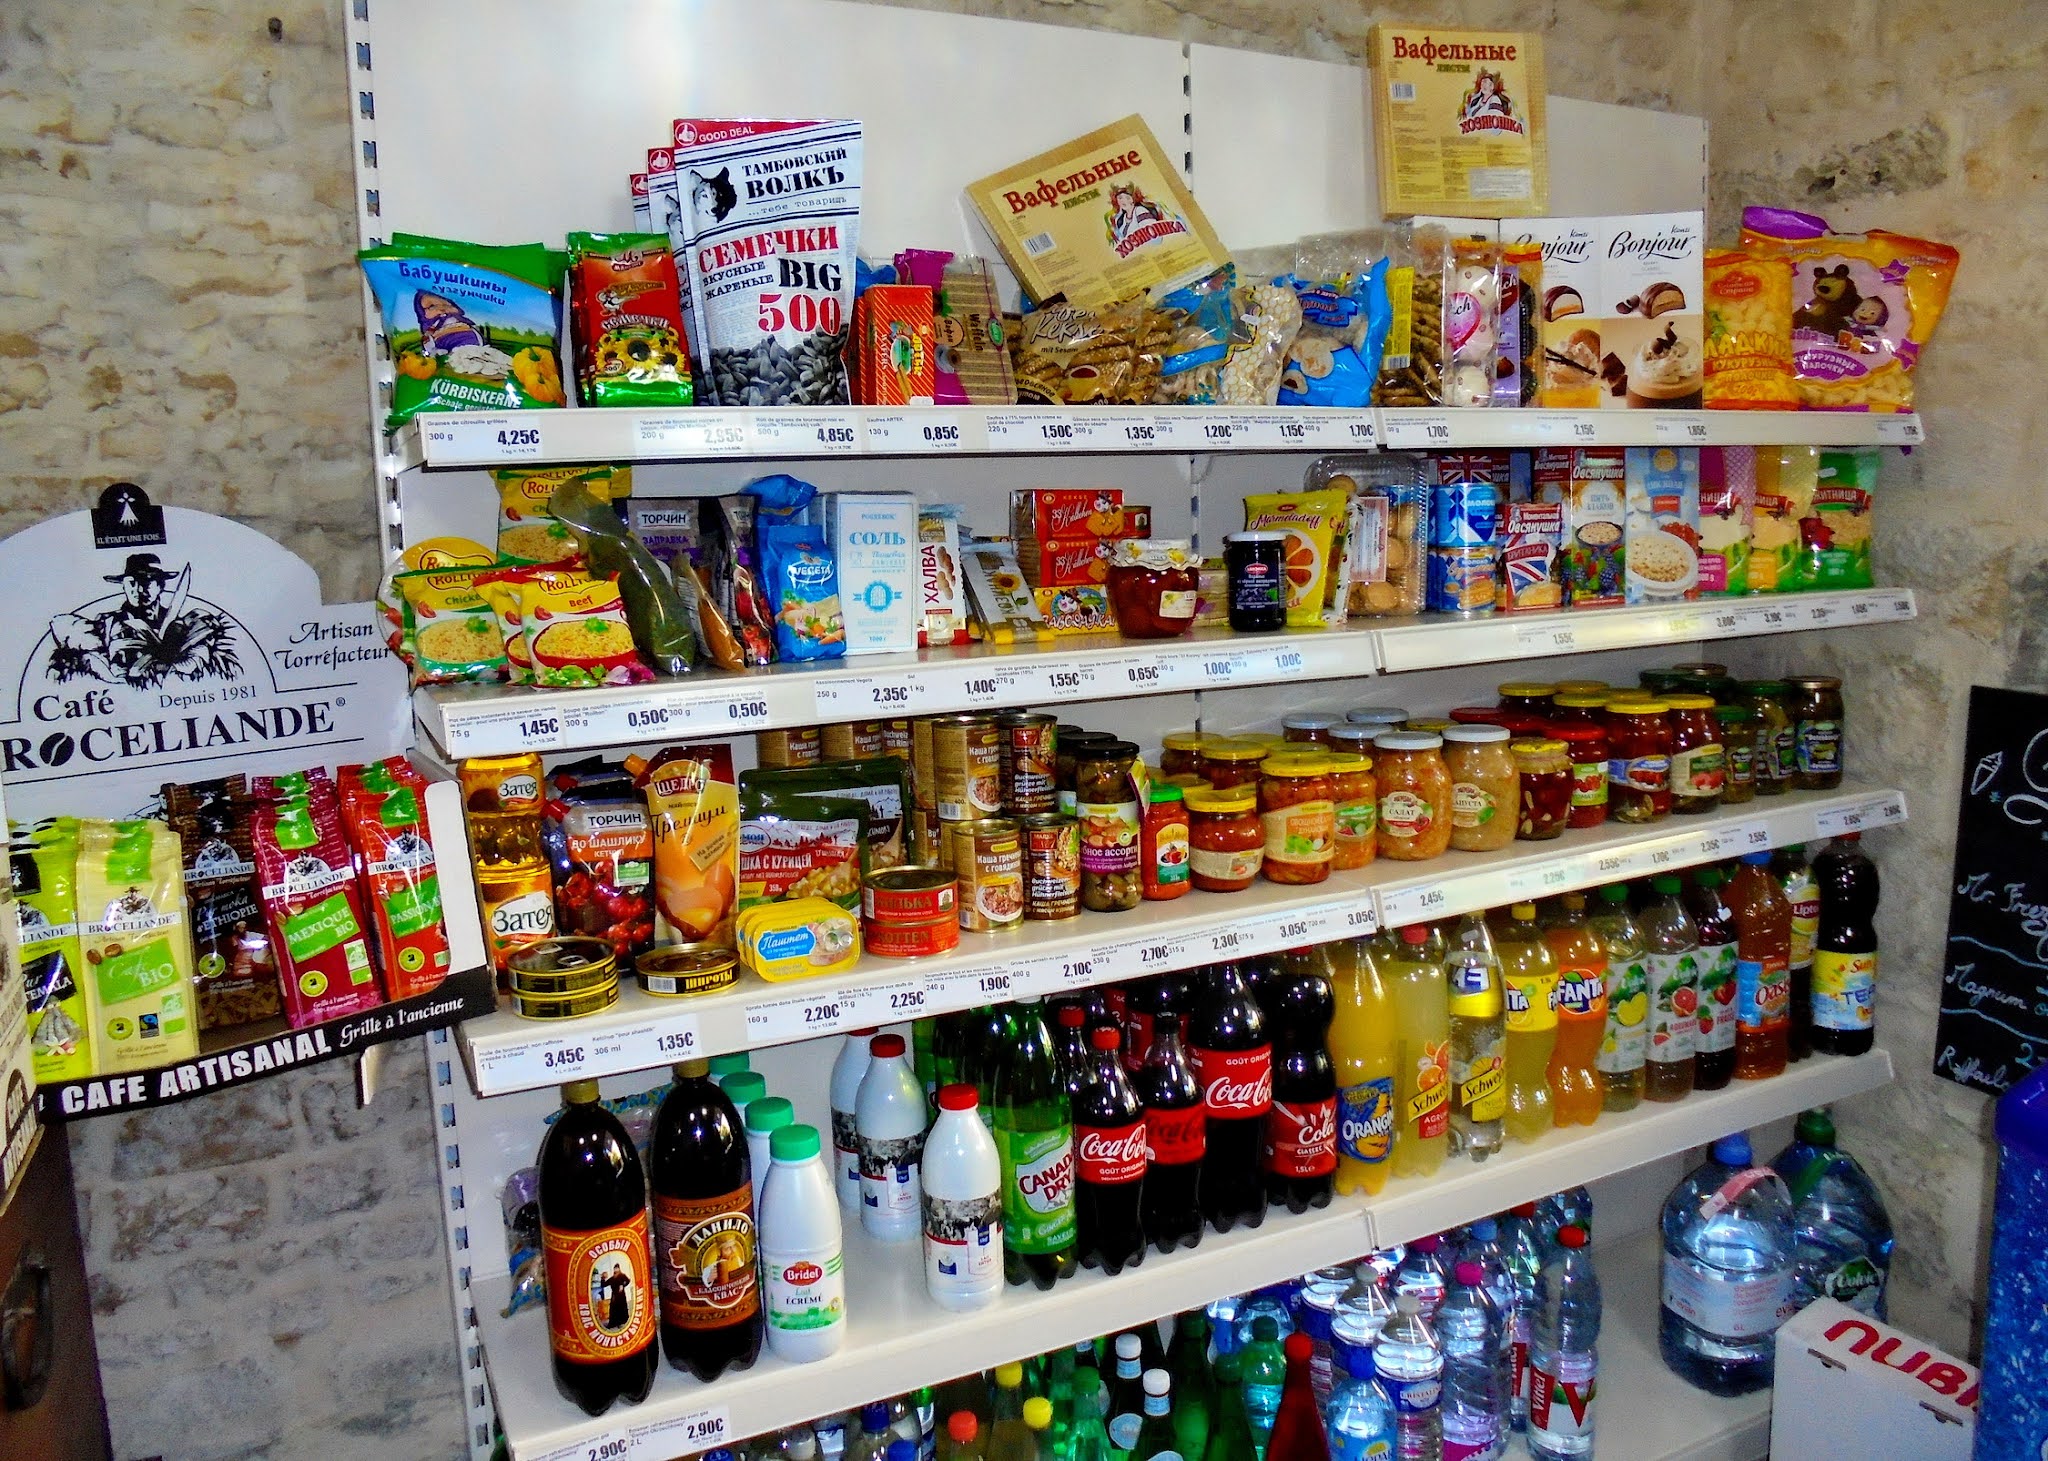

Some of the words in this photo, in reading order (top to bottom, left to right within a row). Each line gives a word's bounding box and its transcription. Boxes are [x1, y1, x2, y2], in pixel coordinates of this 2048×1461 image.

[1392, 37, 1517, 66] Вафельные
[1459, 114, 1523, 135] ХОЗЯЮШКА
[699, 130, 726, 142] GOOD
[730, 126, 754, 137] DEAL
[742, 147, 847, 177] ТАМБОВСКИЙ
[746, 166, 844, 200] ВОЛКЪ
[1002, 148, 1142, 214] Вафельные
[1114, 221, 1187, 258] ХОЗЯЮШКА
[1608, 230, 1696, 262] Bonjour
[700, 226, 838, 272] СЕМЕЧКИ
[399, 262, 508, 294] Бабушкины
[703, 261, 766, 287] ВКУСНЫЕ
[778, 258, 842, 292] BIG
[706, 274, 774, 300] ЖАРЕНЫЕ
[758, 293, 841, 336] 500
[970, 314, 986, 350] Waffeln
[430, 378, 523, 409] KÜRBISKERNE
[498, 429, 539, 446] 4,25€
[641, 431, 656, 439] 200
[817, 428, 854, 442] 4,85€
[923, 426, 958, 441] 0,85€
[1041, 425, 1072, 438] 1,50€
[1125, 427, 1154, 439] 1,35€
[1204, 425, 1232, 438] 1,20€
[1279, 425, 1304, 437] 1,15€
[1350, 424, 1373, 437] 1,70€
[1426, 426, 1448, 438] 1,70€
[1574, 424, 1594, 435] 2,15€
[1573, 466, 1624, 480] Овсянушка
[642, 514, 686, 524] ТОРЧИН
[1507, 521, 1560, 534] Овсянушка
[130, 534, 145, 543] UNE
[642, 535, 689, 544] ЗАПРАВКА
[849, 531, 906, 545] СОЛЬ
[921, 544, 939, 604] ХАЛВА
[569, 596, 593, 607] Beef
[289, 621, 373, 644] Artisan
[1553, 632, 1574, 644] 1,55€
[275, 647, 392, 671] Torréfacteur
[1275, 653, 1301, 668] 1,00€
[1128, 666, 1159, 682] 0,65€
[1204, 661, 1231, 675] 1,00€
[965, 679, 996, 695] 1,40€
[1049, 672, 1080, 688] 1,55€
[159, 690, 215, 710] Depuis
[221, 685, 258, 701] 1981
[873, 687, 908, 703] 2,35€
[33, 688, 115, 724] Café
[669, 709, 683, 717] 300
[729, 702, 767, 719] 0,50€
[565, 719, 580, 727] 300
[628, 708, 669, 727] 0,50€
[520, 718, 559, 737] 1,45€
[969, 746, 988, 756] Каша
[499, 779, 538, 799] Затея
[655, 777, 706, 796] ЩЕДРО
[588, 813, 641, 826] ТОРЧИН
[589, 834, 645, 848] ШАШЛИКУ
[772, 854, 812, 869] КУРИЦЕЙ
[977, 855, 998, 864] Каша
[184, 864, 255, 880] BROCELIANDE
[272, 871, 346, 896] BROCELIANDE
[1420, 890, 1444, 907] 2,45€
[88, 915, 172, 933] BROCELIANDE
[288, 906, 351, 945] MEXIQUE
[493, 904, 554, 932] Затея
[1348, 909, 1374, 926] 3,05€
[336, 920, 354, 937] BIO
[1280, 922, 1307, 938] 3,05€
[762, 932, 809, 949] Паштет
[1212, 933, 1239, 950] 2,30€
[1141, 945, 1169, 962] 2,70€
[139, 963, 174, 987] BIO
[1063, 961, 1092, 978] 2,10€
[685, 971, 733, 989] ШПРОТЫ
[979, 976, 1010, 992] 1,90€
[1946, 963, 2027, 1010] Magnum
[1558, 977, 1604, 1002] FANTA
[890, 991, 924, 1009] 2,25€
[748, 1015, 761, 1023] 160
[762, 1015, 768, 1023] g
[805, 1004, 840, 1022] 2,20€
[657, 1031, 694, 1052] 1,35€
[62, 1078, 148, 1115] CAFE
[159, 1028, 332, 1098] ARTISANAL
[384, 1016, 395, 1032] à
[397, 995, 466, 1028] l'ancienne
[544, 1046, 585, 1069] 3,45€
[594, 1046, 609, 1056] 306
[481, 1063, 485, 1071] 1
[488, 1061, 494, 1069] L
[1226, 1058, 1248, 1066] GOÛT
[1044, 1170, 1073, 1201] DRY
[691, 1216, 749, 1247] ДАНИЛО
[588, 1237, 631, 1260] ОСОБЫЙ
[786, 1267, 823, 1281] Bridel
[577, 1302, 596, 1334] КВАС
[590, 1286, 645, 1348] МОНАСТЫРСКИЙ
[1532, 1372, 1546, 1412] Vittel
[687, 1418, 724, 1439] 2,90€
[588, 1439, 627, 1461] 2,90€
